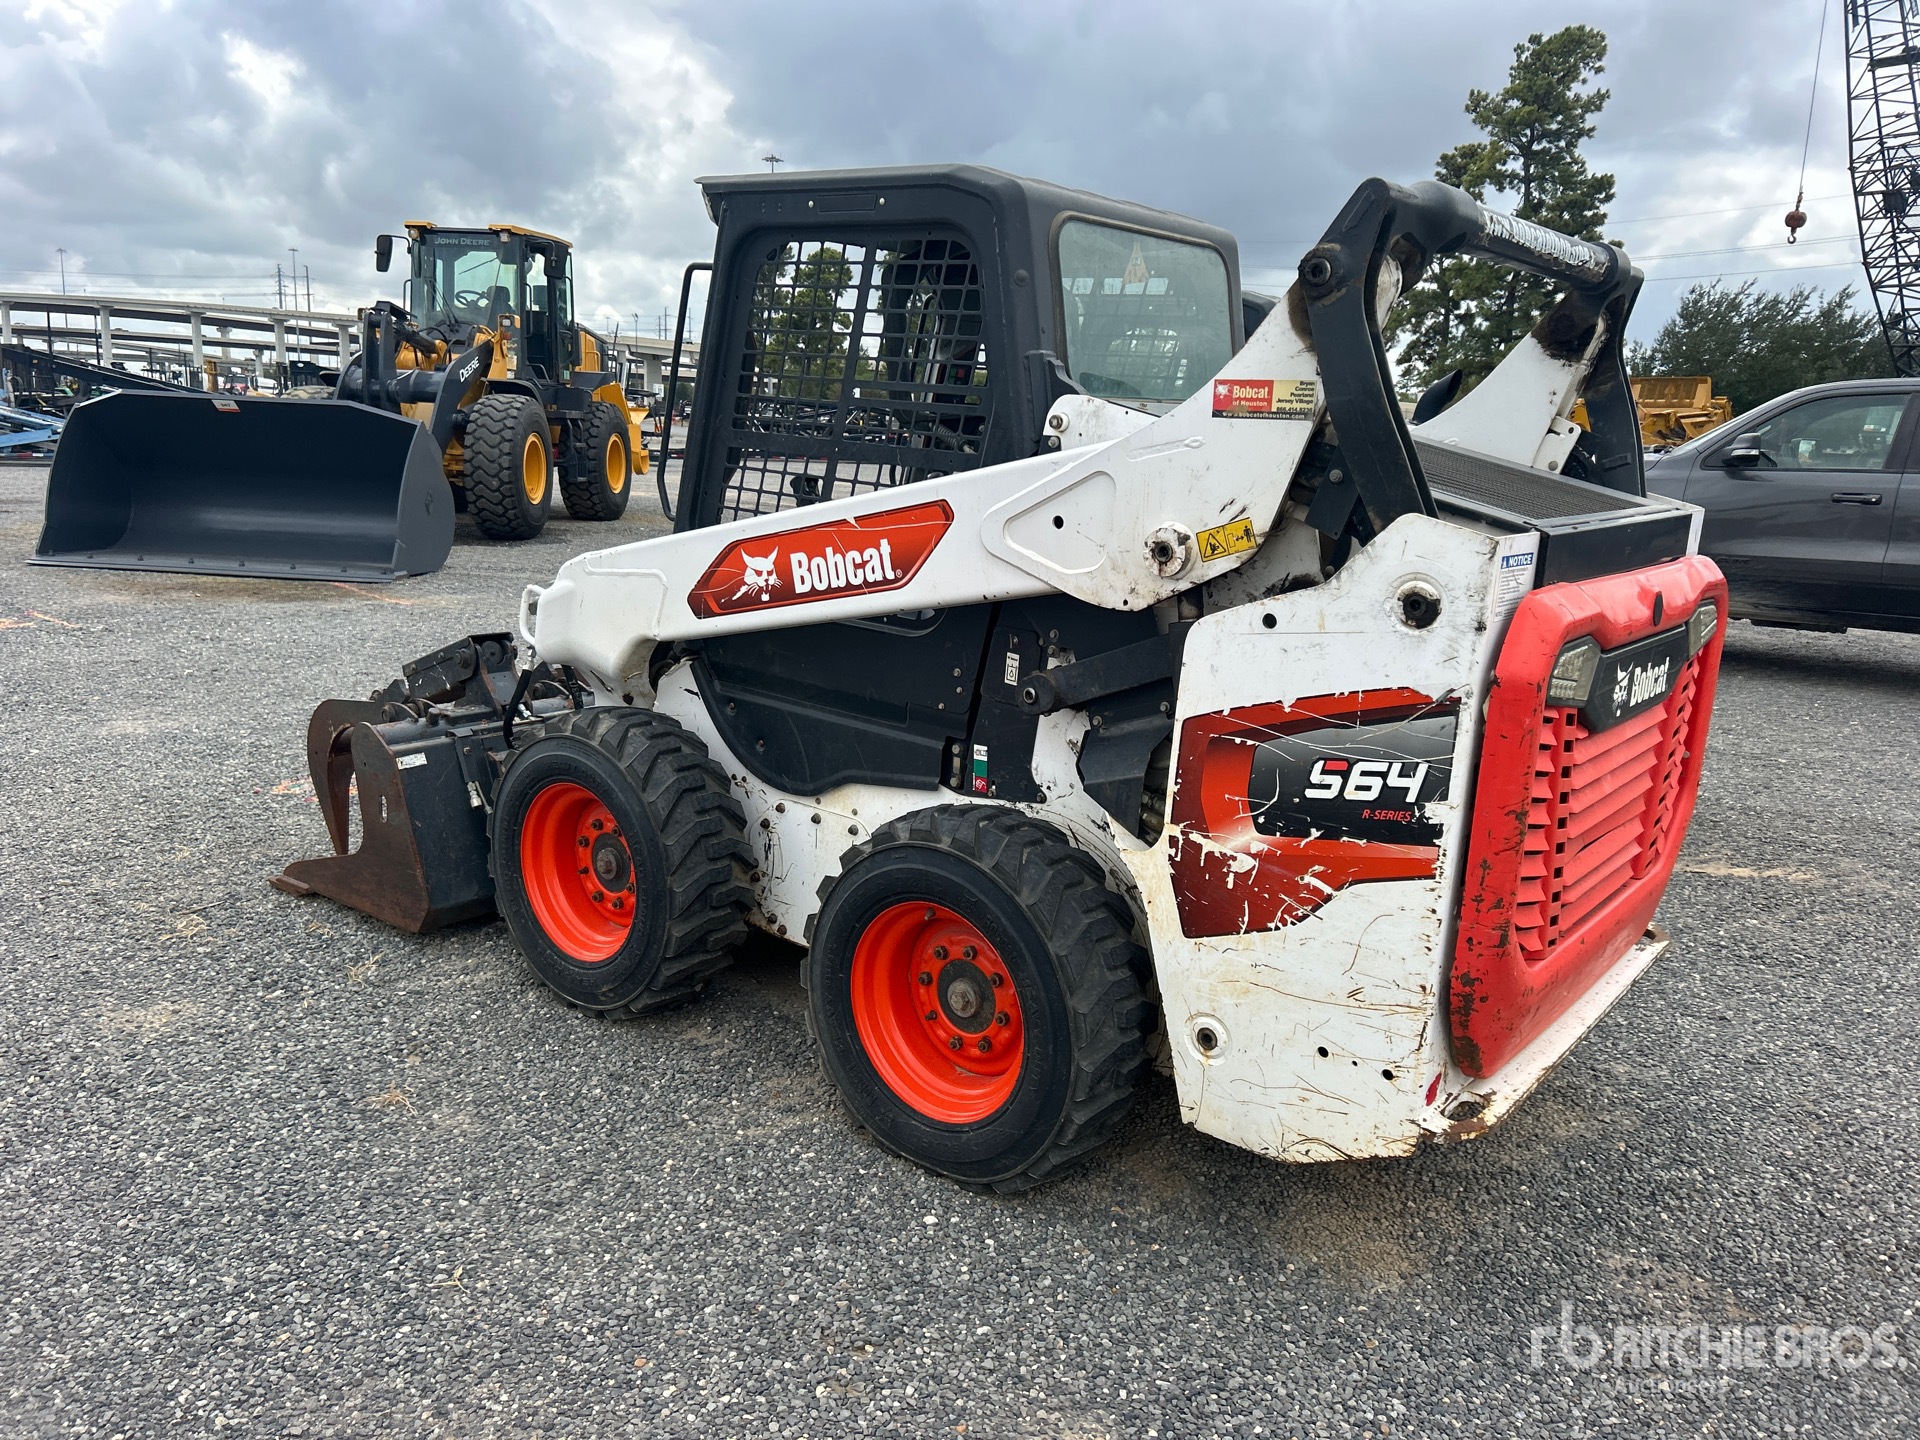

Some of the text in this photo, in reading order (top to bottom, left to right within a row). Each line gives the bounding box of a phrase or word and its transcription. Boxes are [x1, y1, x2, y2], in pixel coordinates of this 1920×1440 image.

[434, 237, 490, 246] JOHN DEERE
[459, 356, 480, 383] DEERE
[1232, 385, 1269, 399] Bobcat
[790, 538, 896, 594] Bobcat
[1508, 554, 1533, 567] NOTICE
[1629, 656, 1670, 708] Bobcat
[1304, 759, 1429, 803] S64
[1361, 808, 1412, 822] R-SERIES
